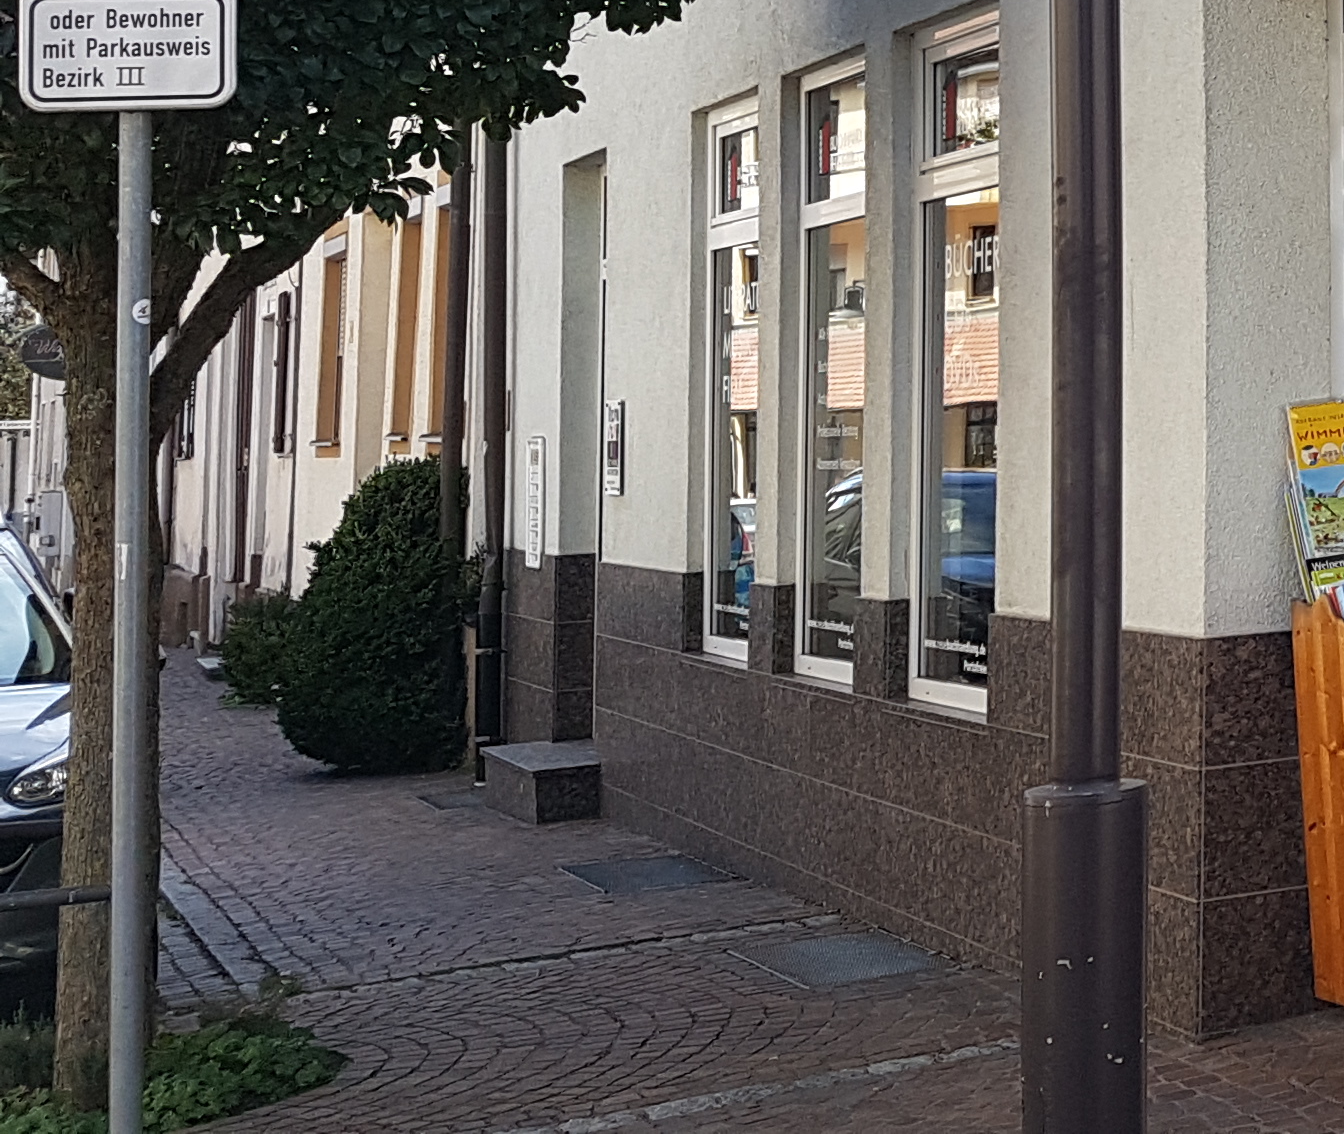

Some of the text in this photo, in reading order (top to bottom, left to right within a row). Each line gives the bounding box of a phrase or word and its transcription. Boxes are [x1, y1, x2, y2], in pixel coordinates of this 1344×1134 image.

[50, 7, 204, 30] oder Bewohner
[43, 36, 211, 60] mit Parkausweis
[43, 66, 145, 88] Bezirk III
